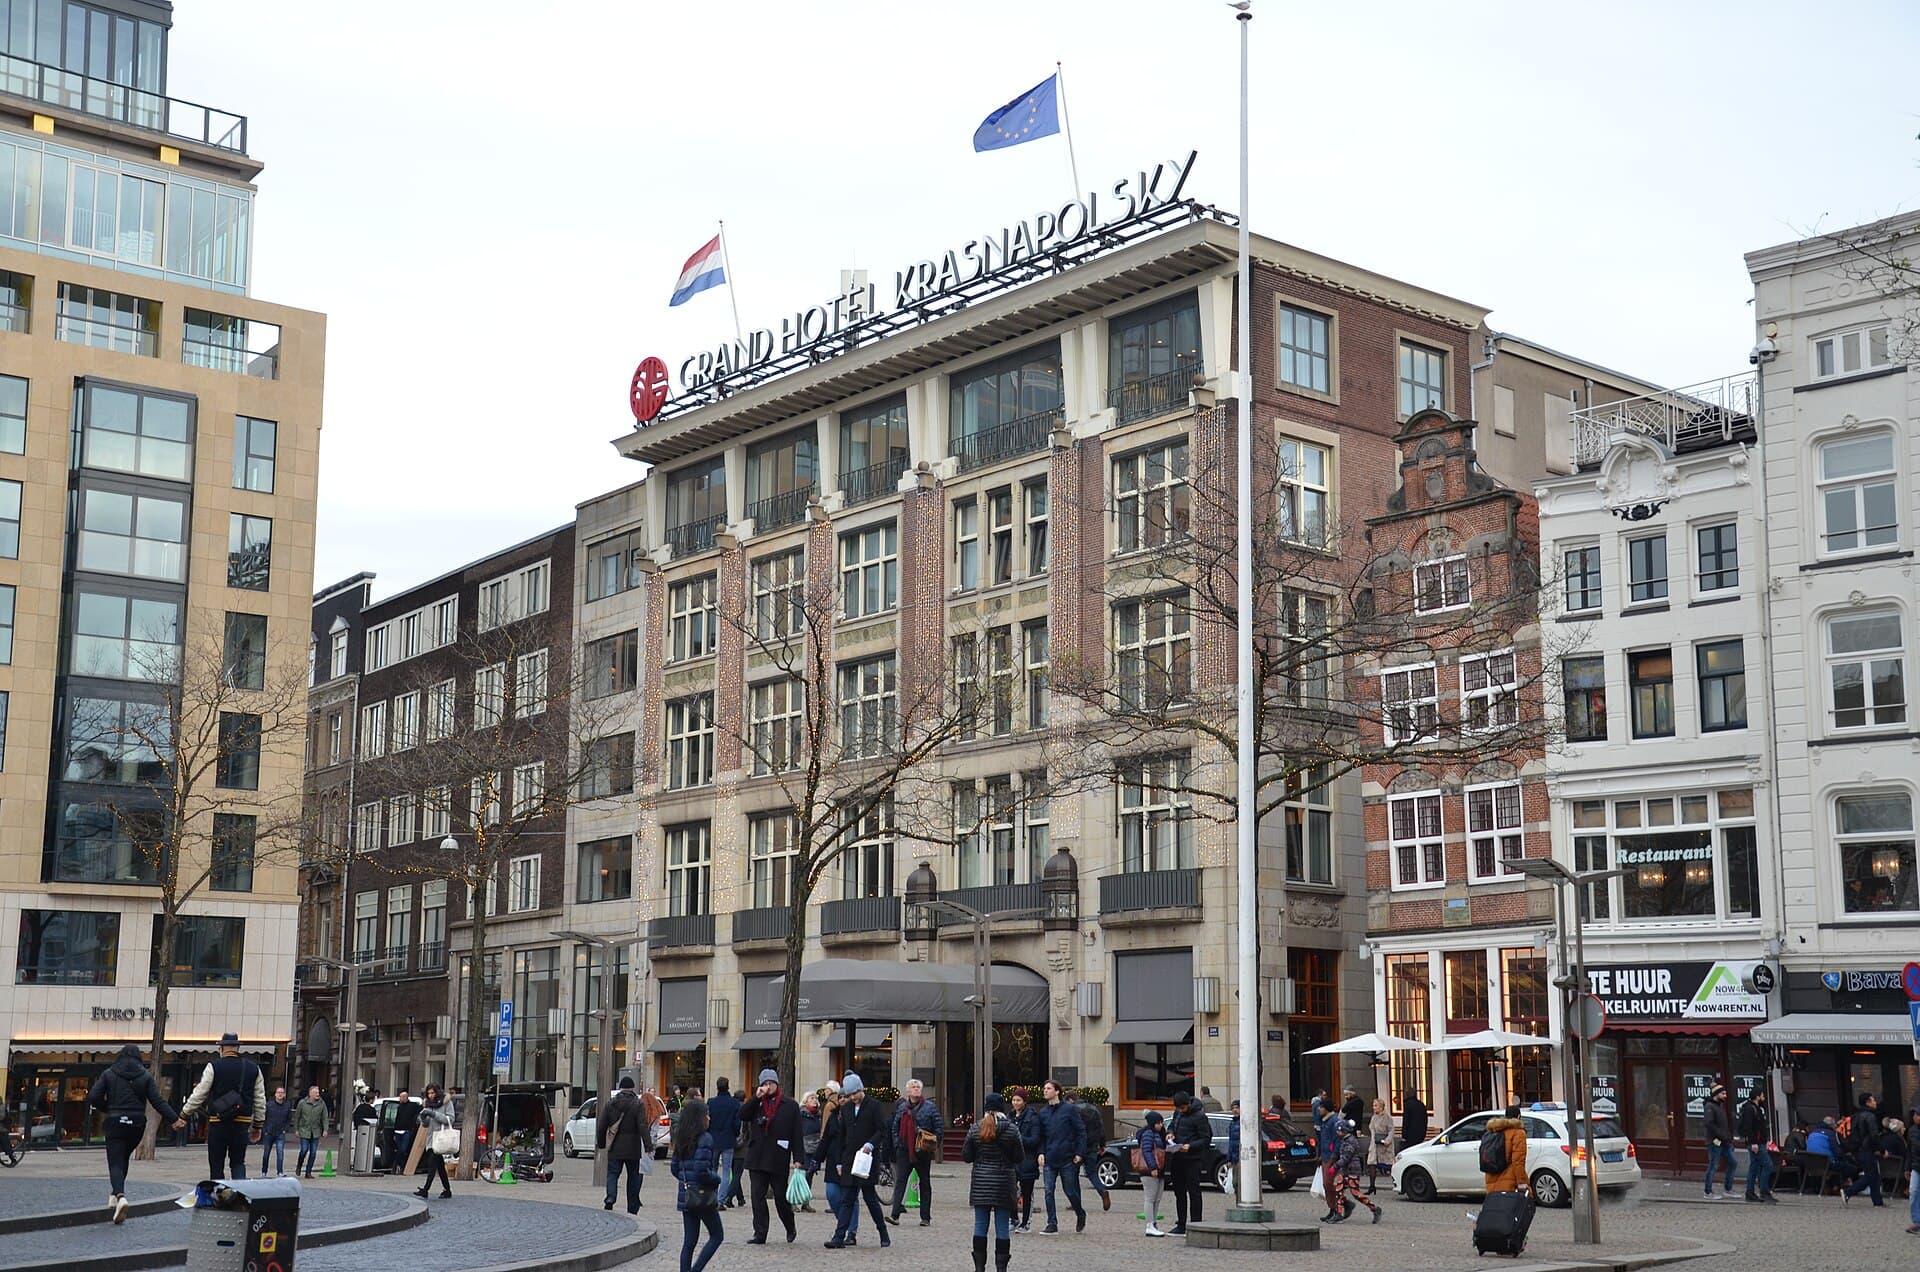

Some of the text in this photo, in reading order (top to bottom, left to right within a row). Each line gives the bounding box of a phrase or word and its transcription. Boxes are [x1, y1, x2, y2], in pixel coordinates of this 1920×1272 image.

[680, 150, 1198, 392] GRAND HOTEL KRASNAPOLSKY
[1616, 845, 1712, 864] Restaurant
[1588, 969, 1671, 995] TE HUUR
[1846, 970, 1903, 991] Bava
[1715, 985, 1746, 993] NOW4R
[91, 1006, 136, 1021] EURO
[503, 1003, 511, 1020] P
[1600, 998, 1688, 1014] KELRUIMTE
[1694, 1003, 1763, 1013] NOW4RENT.NL
[498, 1038, 508, 1053] P
[496, 1055, 509, 1063] taxi
[1598, 1077, 1608, 1087] TE
[1693, 1077, 1704, 1087] TE
[1743, 1077, 1754, 1087] TE
[1592, 1087, 1615, 1097] HUUR
[1687, 1086, 1711, 1097] HUUR
[252, 1215, 267, 1232] 020
